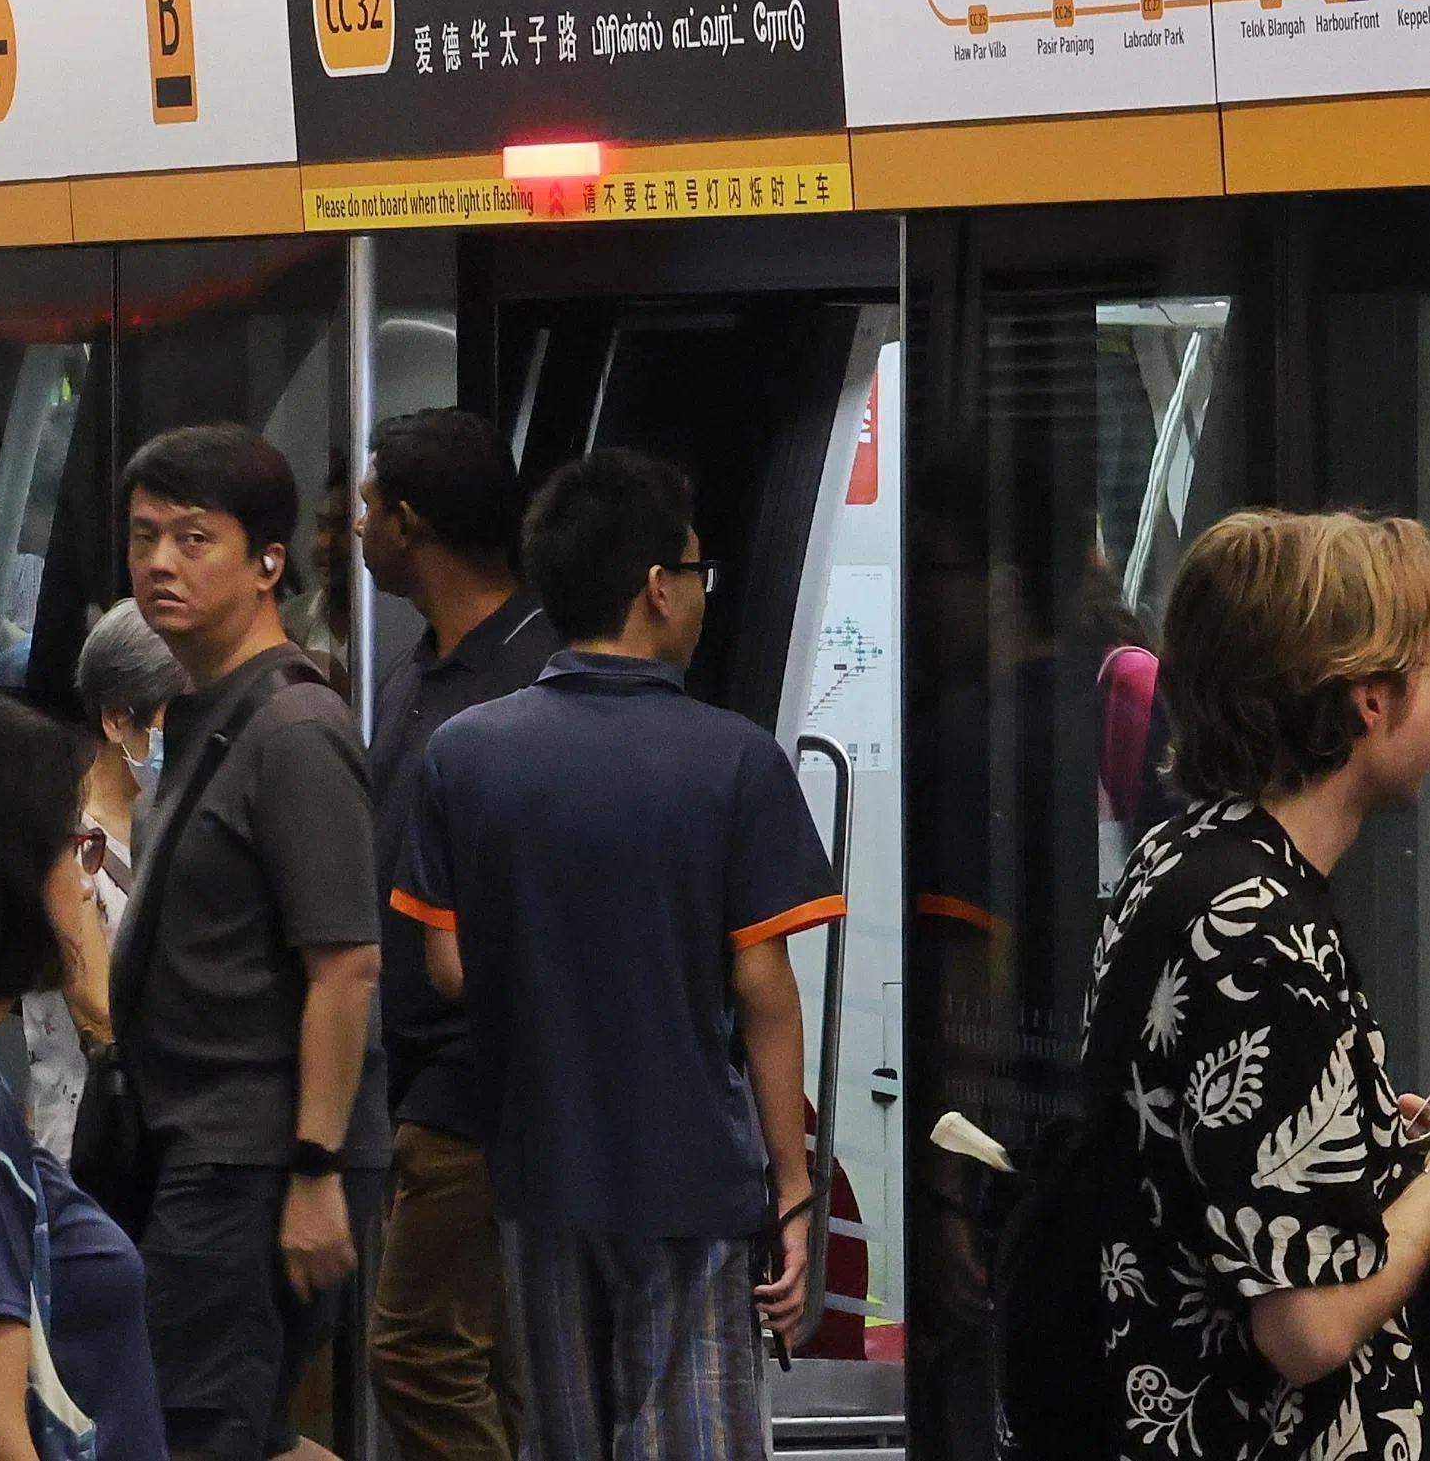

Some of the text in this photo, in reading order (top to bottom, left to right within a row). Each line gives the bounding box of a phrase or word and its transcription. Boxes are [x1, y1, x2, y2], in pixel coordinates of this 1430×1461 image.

[1241, 16, 1305, 39] Telok Blangah
[1316, 12, 1380, 32] HarbourFront
[1397, 6, 1430, 30] Keppel
[413, 11, 577, 75] 爱德华太子路
[1037, 35, 1094, 56] Pasir Panjang
[1124, 26, 1185, 48] Labrador Park
[954, 41, 1007, 61] Haw Par Villa
[316, 185, 533, 219] Please do not board when the light is flashing
